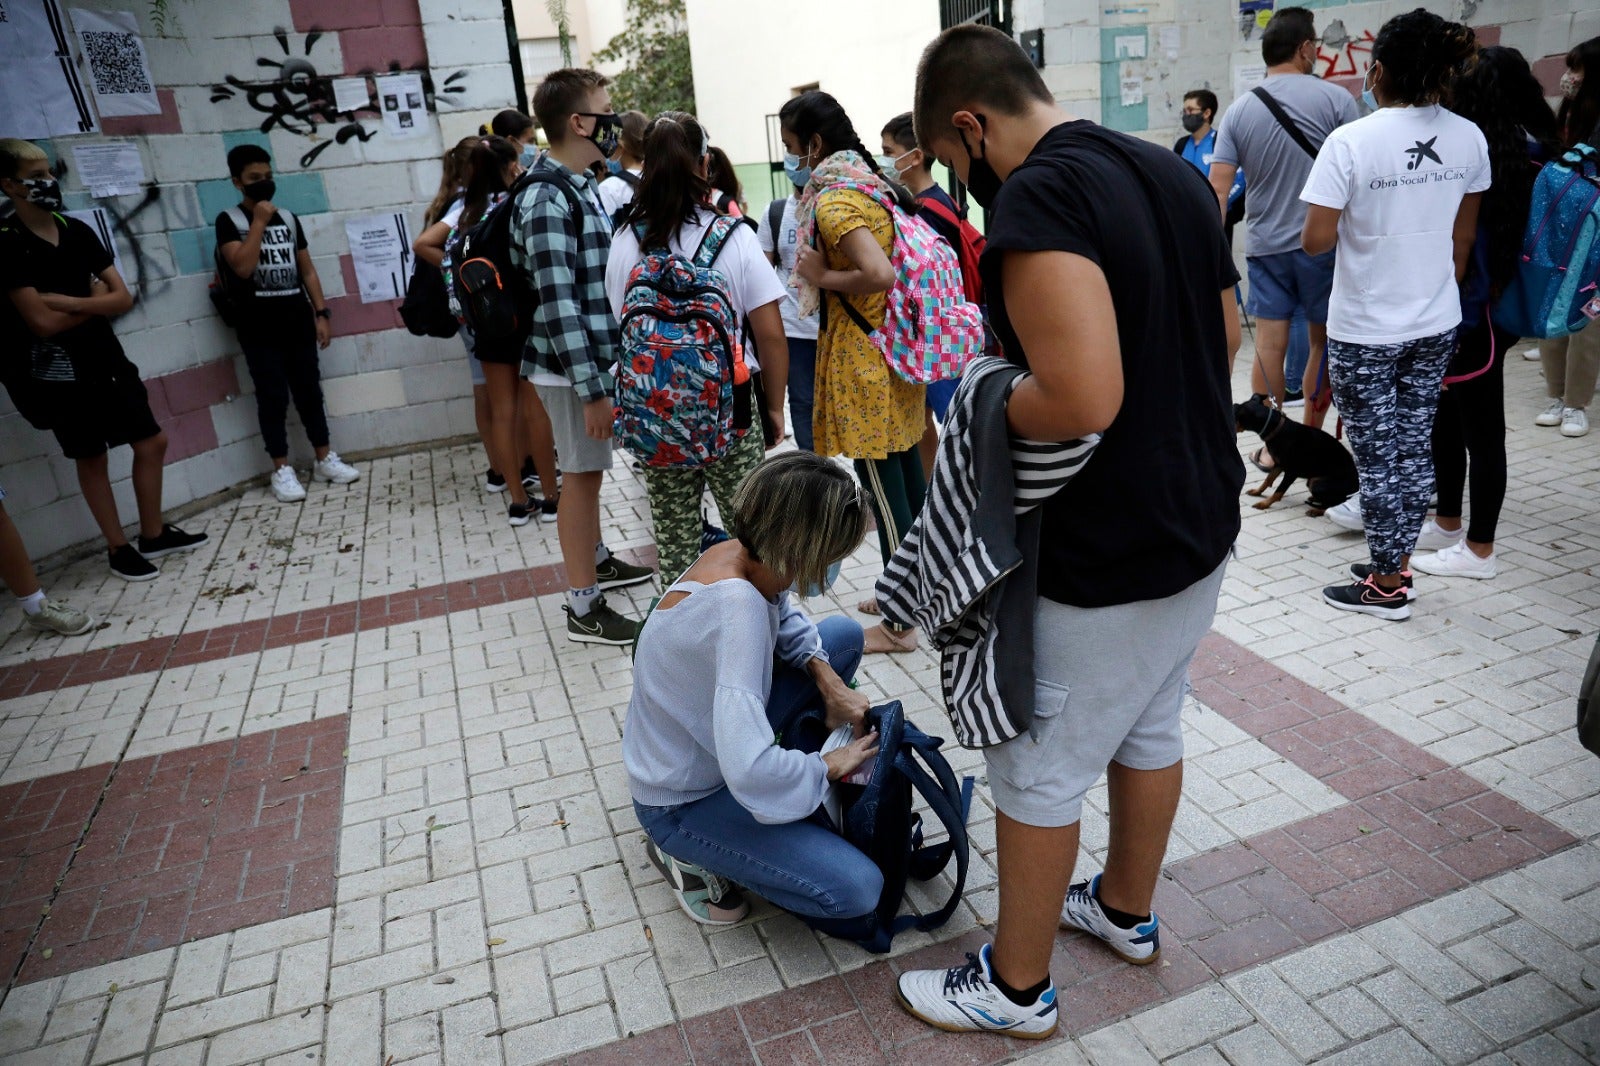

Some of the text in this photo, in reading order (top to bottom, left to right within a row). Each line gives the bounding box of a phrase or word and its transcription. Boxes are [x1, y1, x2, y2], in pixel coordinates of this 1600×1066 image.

[1370, 179, 1398, 190] Obra
[1400, 175, 1428, 185] Social
[259, 247, 291, 265] NEW
